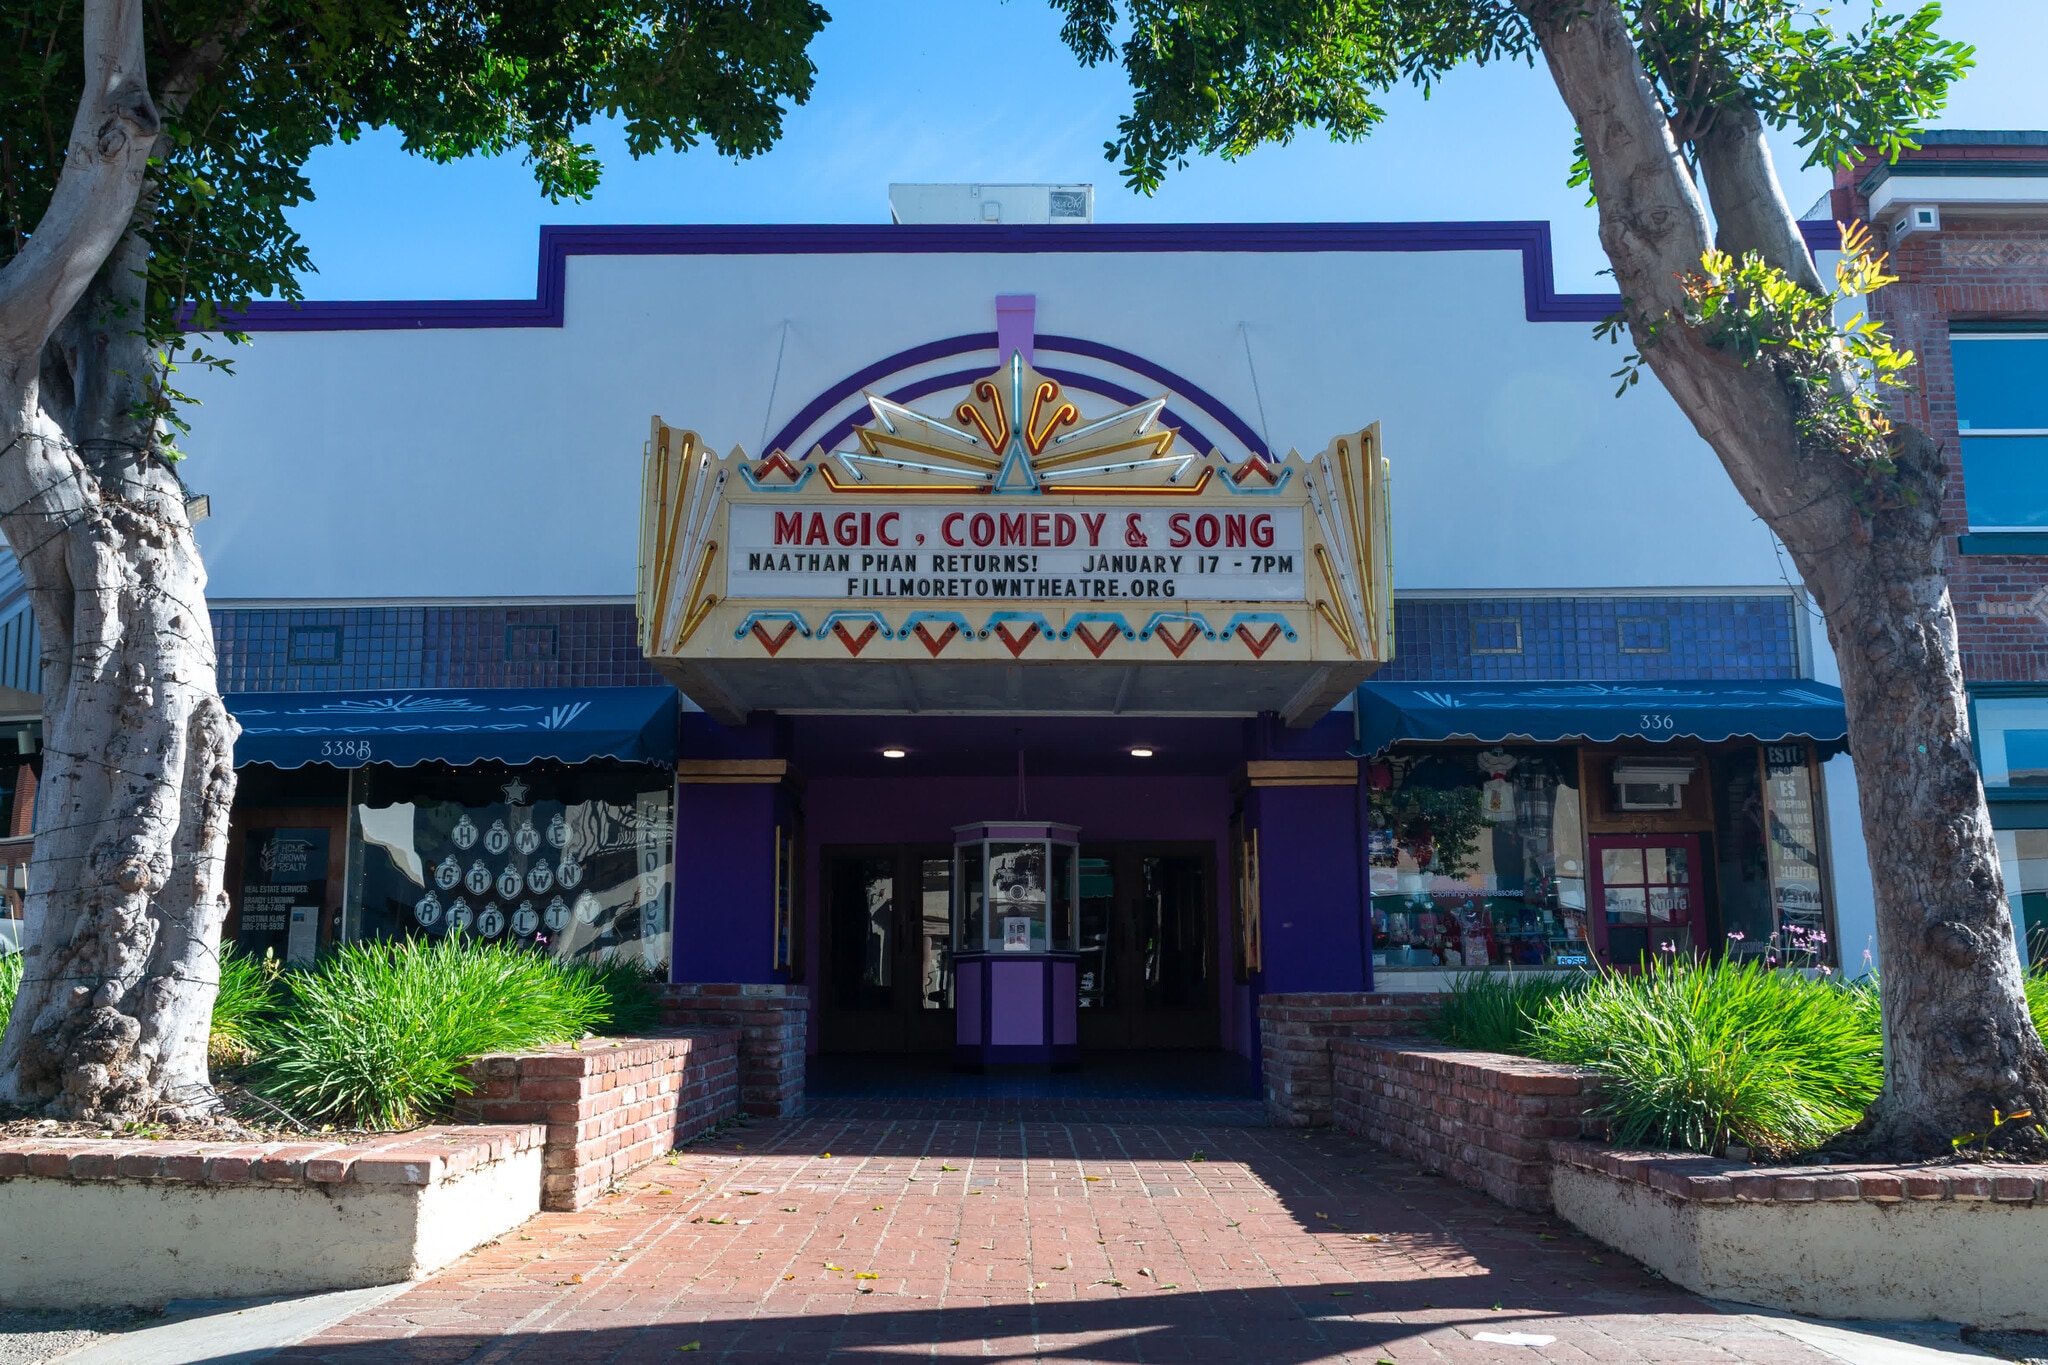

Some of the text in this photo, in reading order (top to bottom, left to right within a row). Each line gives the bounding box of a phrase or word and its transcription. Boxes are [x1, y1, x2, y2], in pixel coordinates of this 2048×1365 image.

[941, 512, 1106, 547] COMEDY
[1124, 512, 1148, 548] &
[1169, 512, 1273, 547] SONG
[748, 554, 850, 573] NAATHAN
[862, 554, 917, 573] PHAN
[932, 554, 1039, 573] RETURNS!
[1082, 554, 1183, 574] JANUARY
[1199, 555, 1220, 574] 17
[1251, 555, 1293, 574] 7PM
[847, 577, 1175, 598] FILLMORETOWNTHEATRE.ORG
[1640, 714, 1673, 730] 336
[321, 740, 371, 760] 338B
[1780, 780, 1796, 797] ES
[458, 825, 567, 850] HOME
[278, 854, 307, 862] GROWN
[282, 845, 305, 853] HOME
[1783, 848, 1793, 860] ES
[278, 863, 307, 872] REALTY
[441, 865, 576, 897] GROWN
[1431, 888, 1466, 899] Clothing
[420, 902, 592, 933] REALTY
